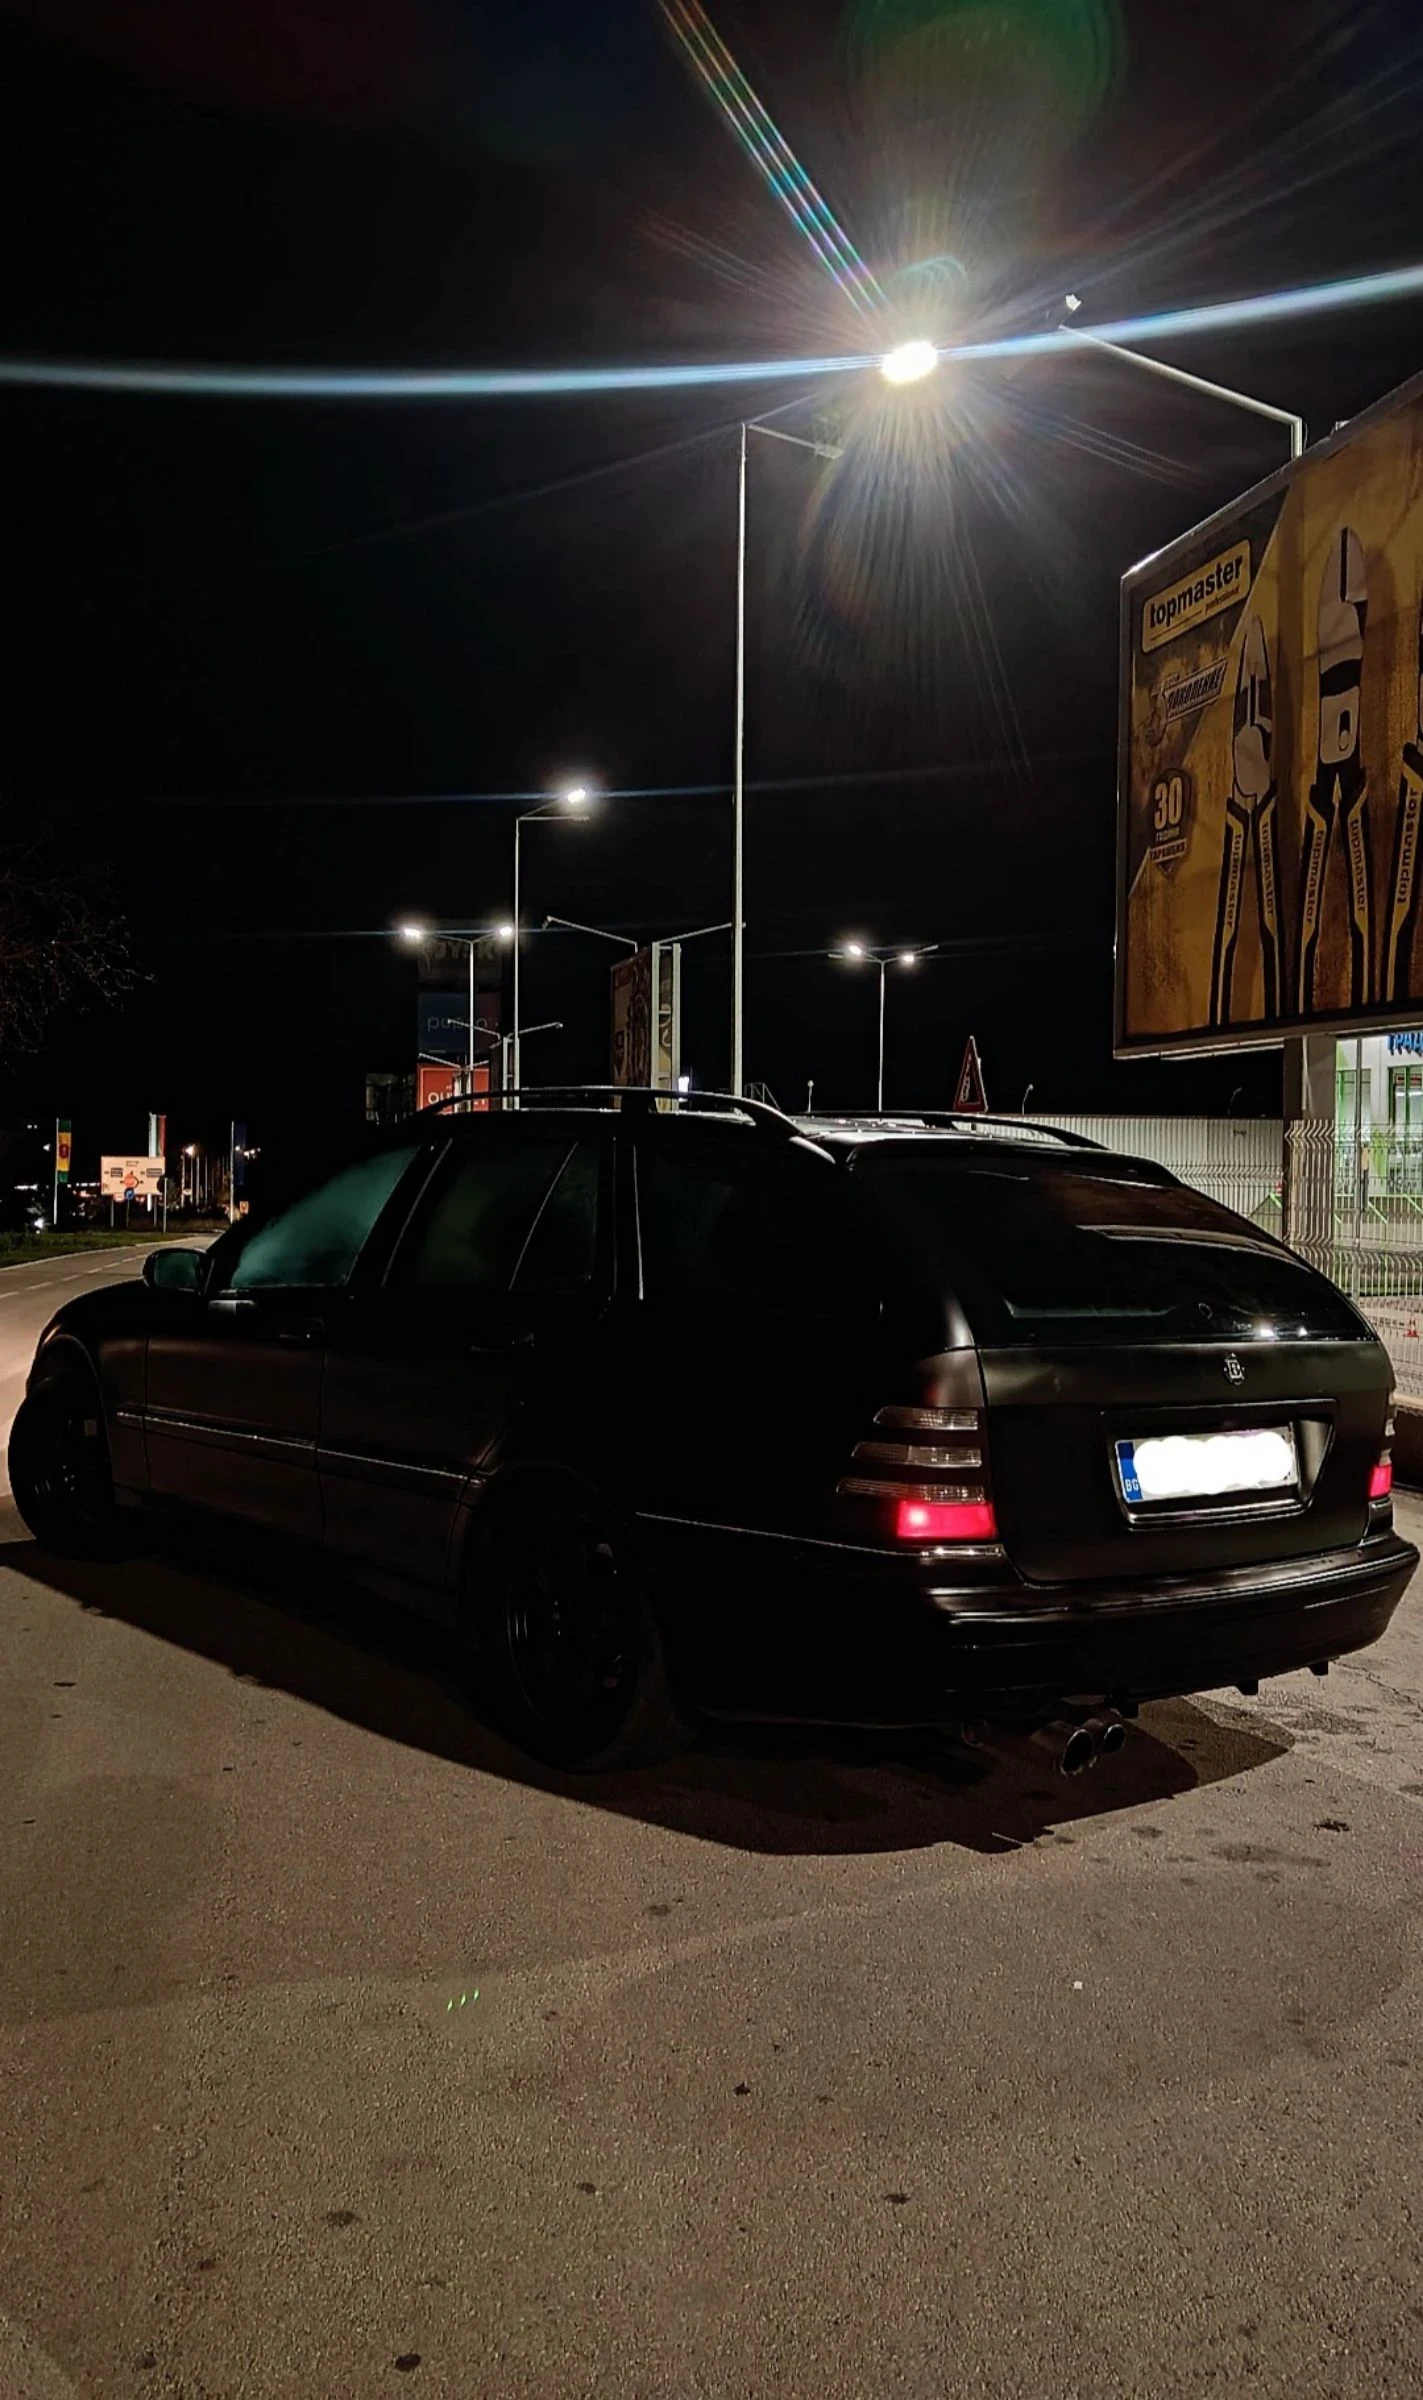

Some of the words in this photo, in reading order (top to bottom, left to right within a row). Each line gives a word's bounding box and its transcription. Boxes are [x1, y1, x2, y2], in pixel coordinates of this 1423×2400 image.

[1150, 555, 1244, 629] topmaster
[1154, 776, 1183, 830] 30
[1397, 788, 1419, 905] topmaster
[1227, 833, 1242, 929] topmaster
[1261, 822, 1275, 917] topmaster
[1305, 829, 1325, 924] topmaster
[1350, 818, 1366, 913] topmaster
[1124, 1478, 1140, 1492] BG
